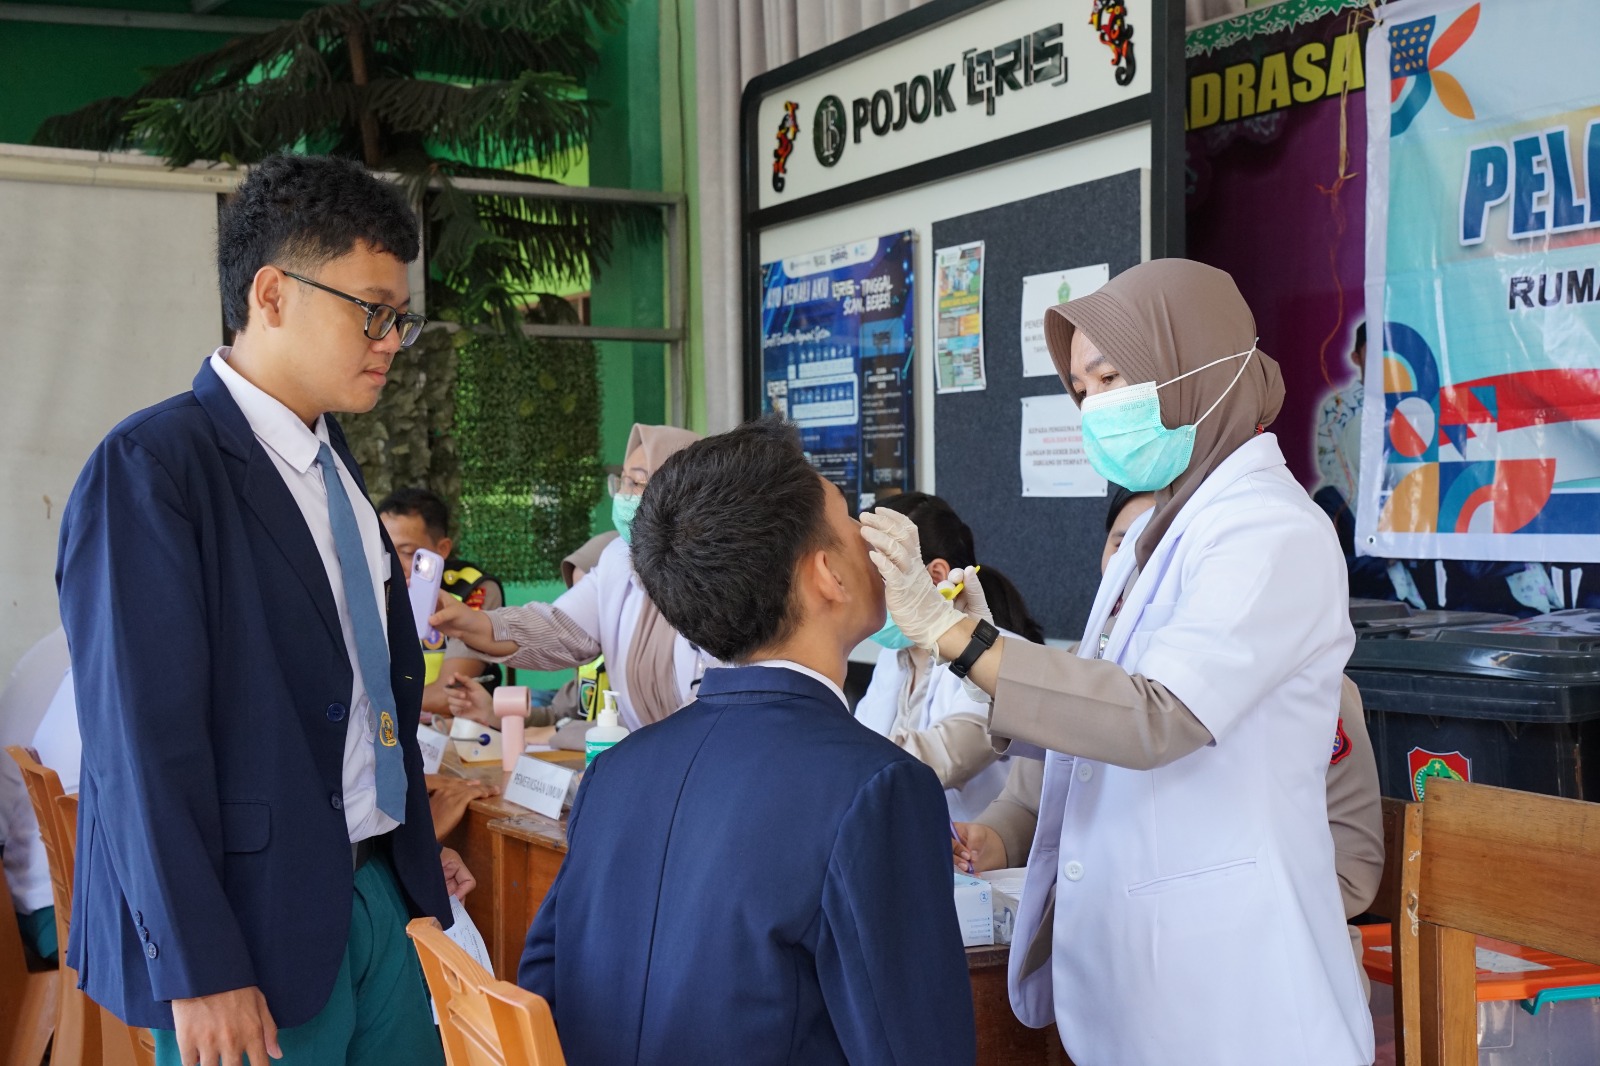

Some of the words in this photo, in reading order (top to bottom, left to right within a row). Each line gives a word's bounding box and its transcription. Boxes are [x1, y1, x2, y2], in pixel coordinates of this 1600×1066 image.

[852, 63, 957, 144] POJOK
[964, 22, 1067, 116] QRIS
[1185, 32, 1369, 132] DRASA
[1509, 267, 1600, 310] RUM
[513, 772, 547, 795] PEMERIKSAAN
